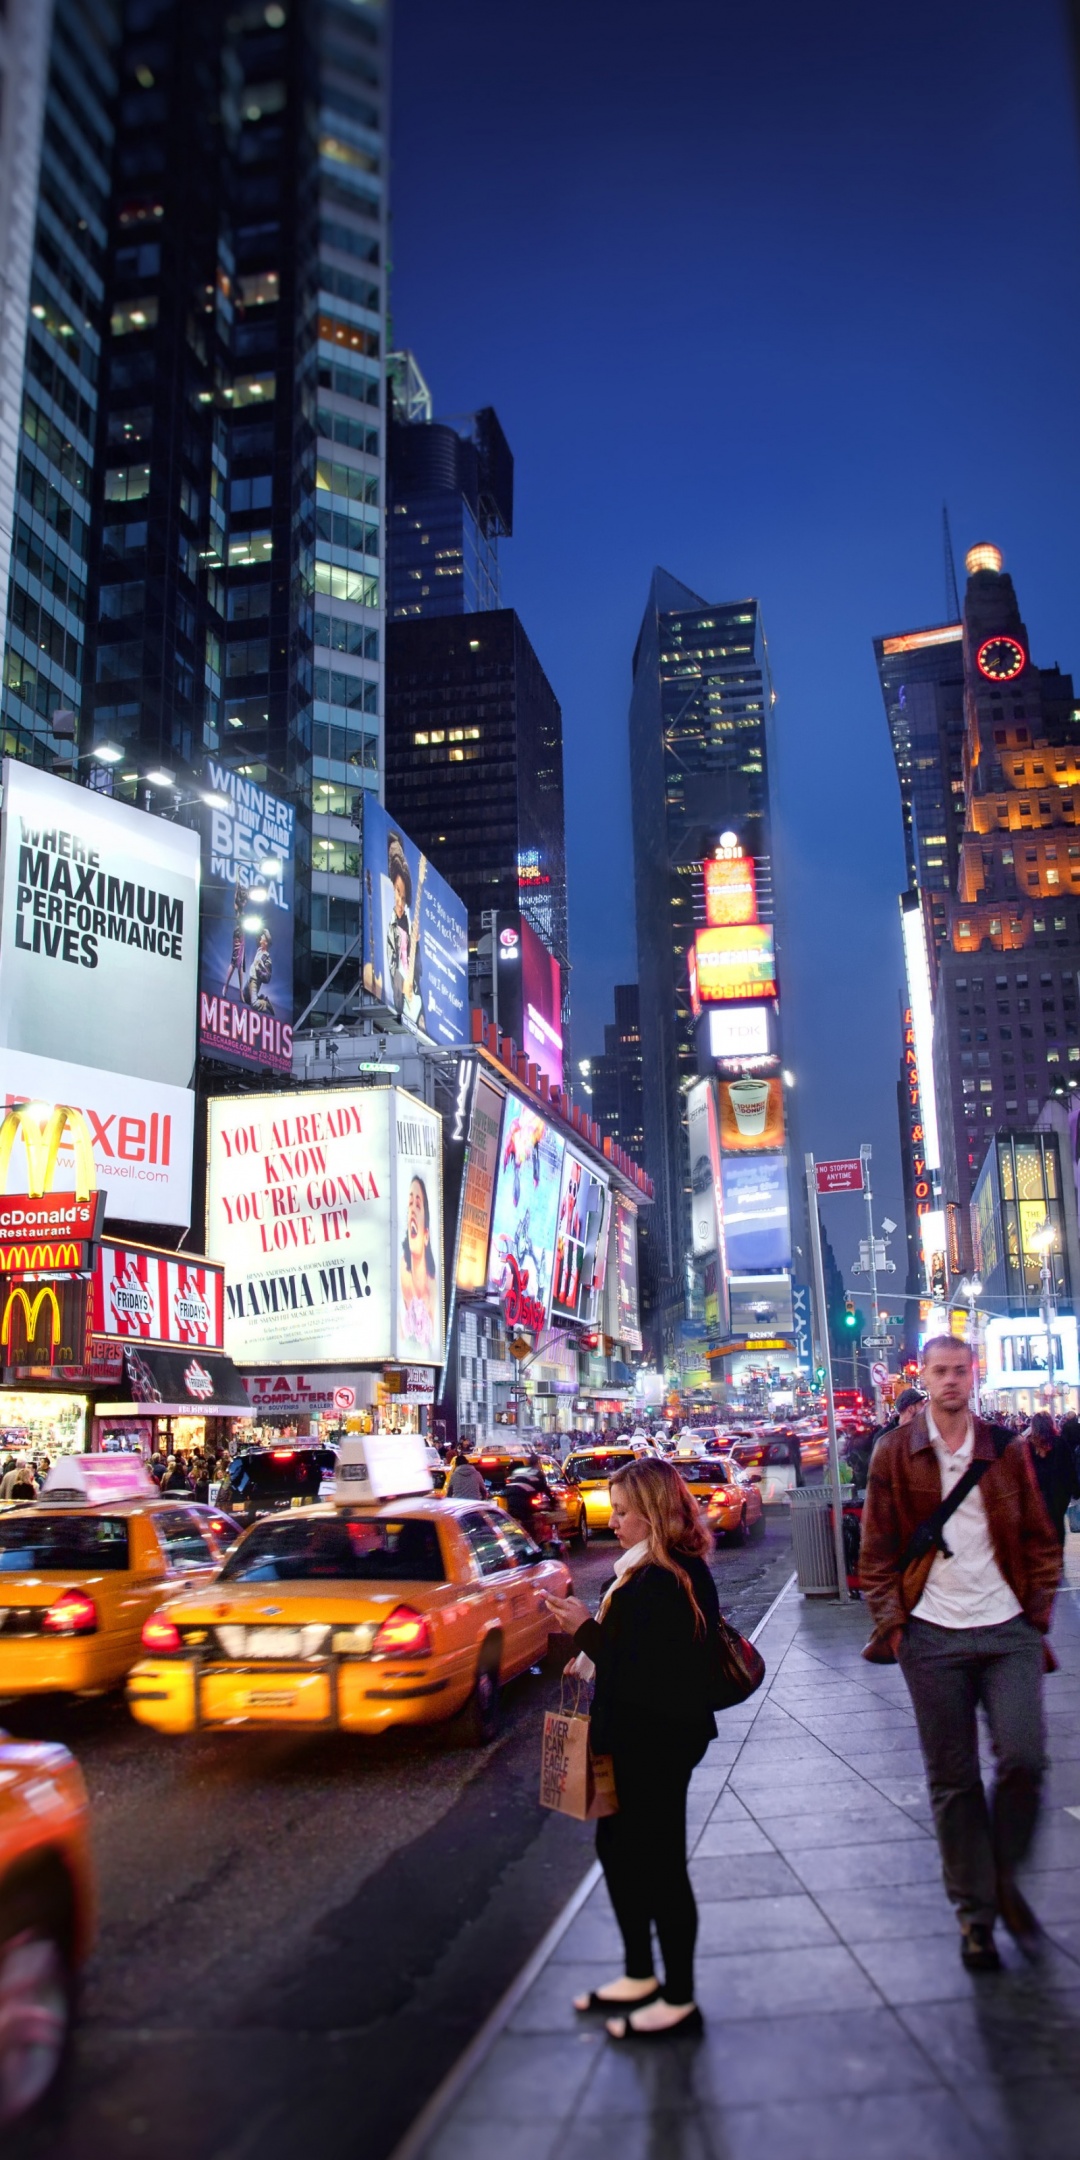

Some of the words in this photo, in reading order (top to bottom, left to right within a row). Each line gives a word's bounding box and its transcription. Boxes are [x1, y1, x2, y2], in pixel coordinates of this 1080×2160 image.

[209, 761, 293, 831] WINNER!
[20, 816, 100, 868] WHERE
[211, 809, 289, 884] BEST
[238, 803, 260, 832] TONY
[262, 817, 290, 847] AWARD
[715, 847, 742, 860] 2011
[18, 844, 184, 935] MAXIMUM
[211, 850, 289, 910] MUSICAL
[15, 914, 98, 969] LIVES
[17, 885, 183, 961] PERFORMANCE
[500, 947, 518, 960] LG
[697, 949, 775, 967] TOSHIBA
[702, 981, 776, 1000] TOSHIBA
[201, 991, 293, 1059] MEMPHIS
[904, 1008, 919, 1105] ERNST
[5, 1093, 171, 1166] xell
[221, 1124, 263, 1158] YOU
[269, 1104, 363, 1150] ALREADY
[264, 1144, 329, 1184] KNOW
[826, 1172, 852, 1181] ANYTIME
[829, 1163, 858, 1172] STOPPING
[221, 1183, 300, 1225] YOU'RE
[306, 1170, 380, 1211] GONNA
[0, 1225, 71, 1239] Restaurant
[259, 1215, 315, 1253] LOVE
[320, 1208, 351, 1243] IT!
[226, 1273, 315, 1320] MAMMA
[318, 1260, 372, 1305] MIA!
[748, 1331, 774, 1339] SONY
[252, 1392, 334, 1404] COMPUTERS
[545, 1717, 568, 1740] AMER
[543, 1768, 567, 1792] SINCE
[544, 1751, 569, 1772] EAGLE
